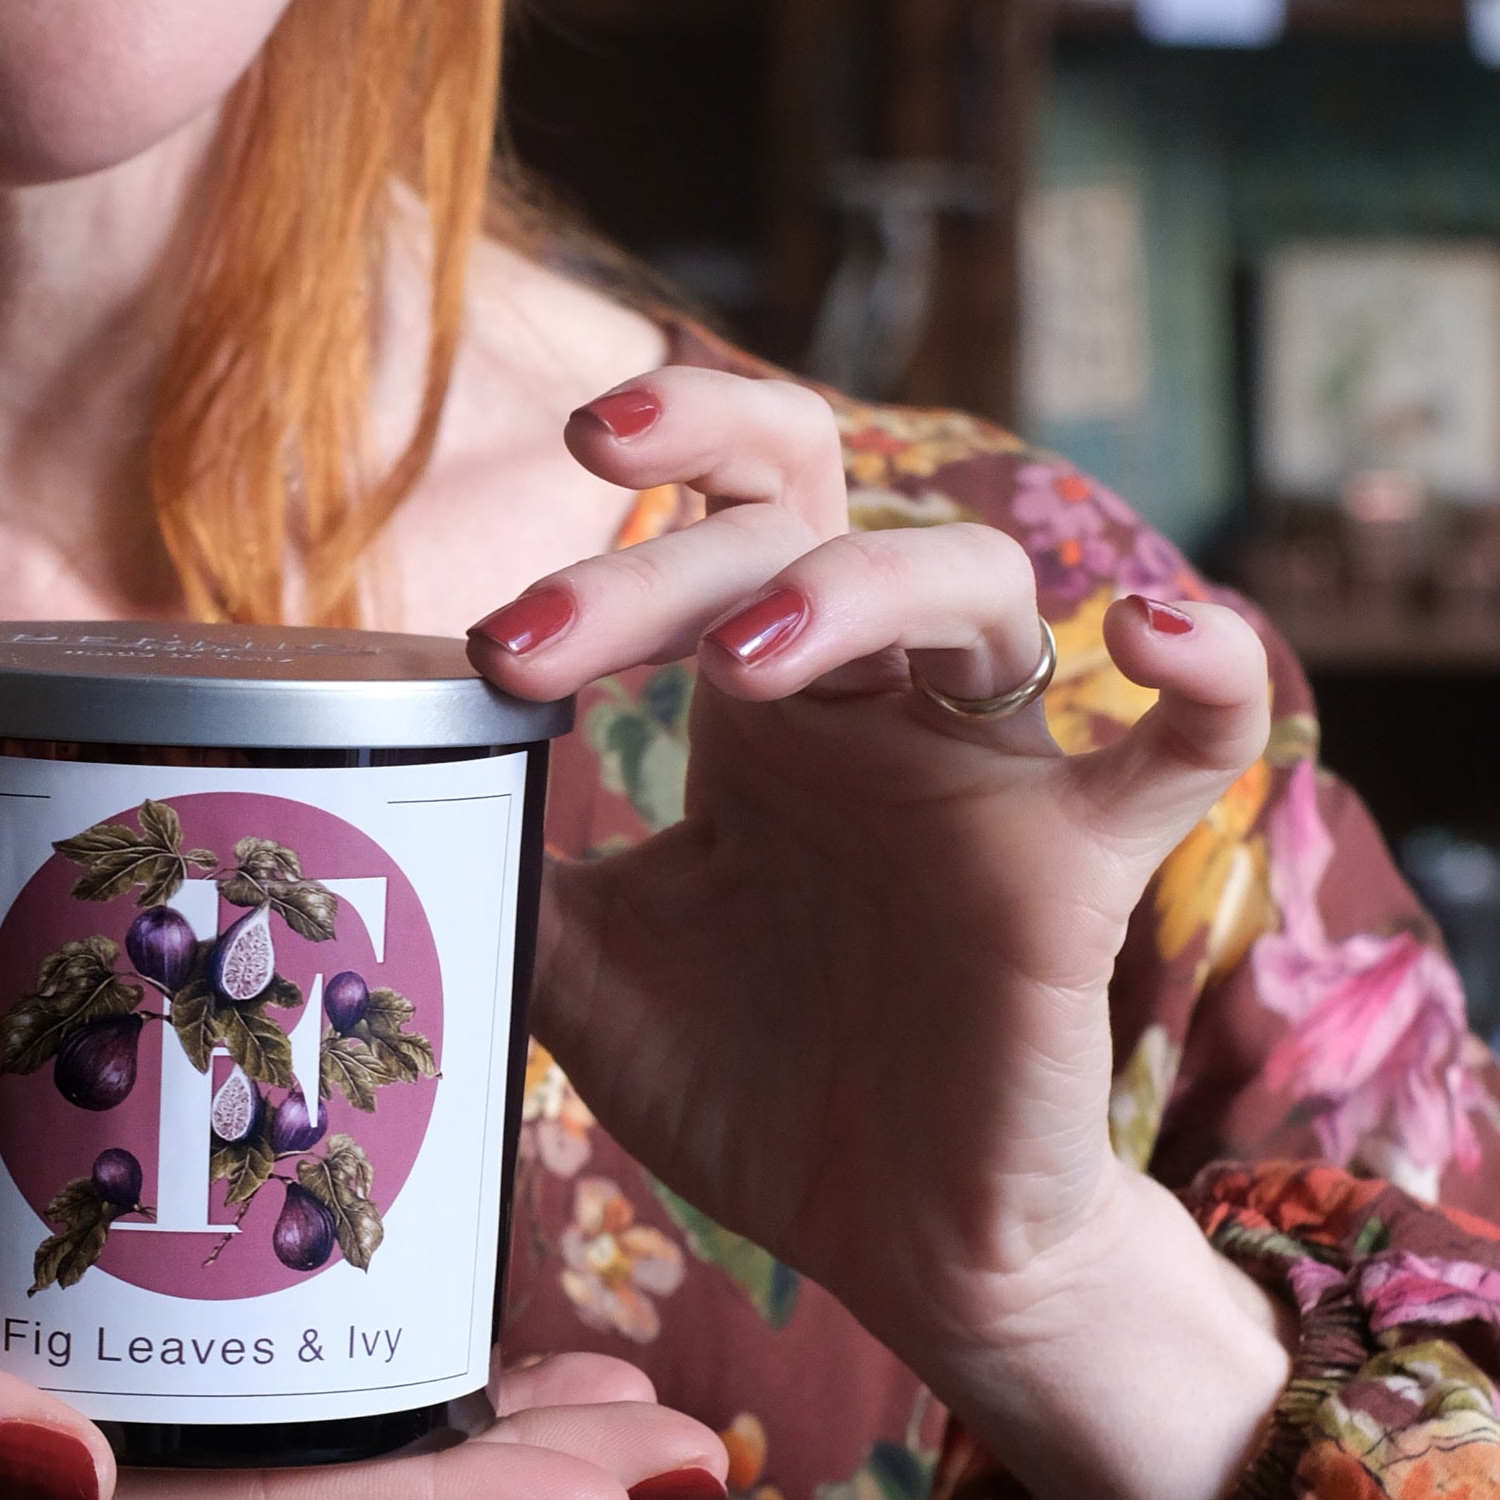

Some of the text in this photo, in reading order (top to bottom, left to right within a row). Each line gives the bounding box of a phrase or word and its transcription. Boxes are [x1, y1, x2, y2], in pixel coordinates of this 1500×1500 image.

[3, 1317, 403, 1368] Fig Leaves & Ivy
